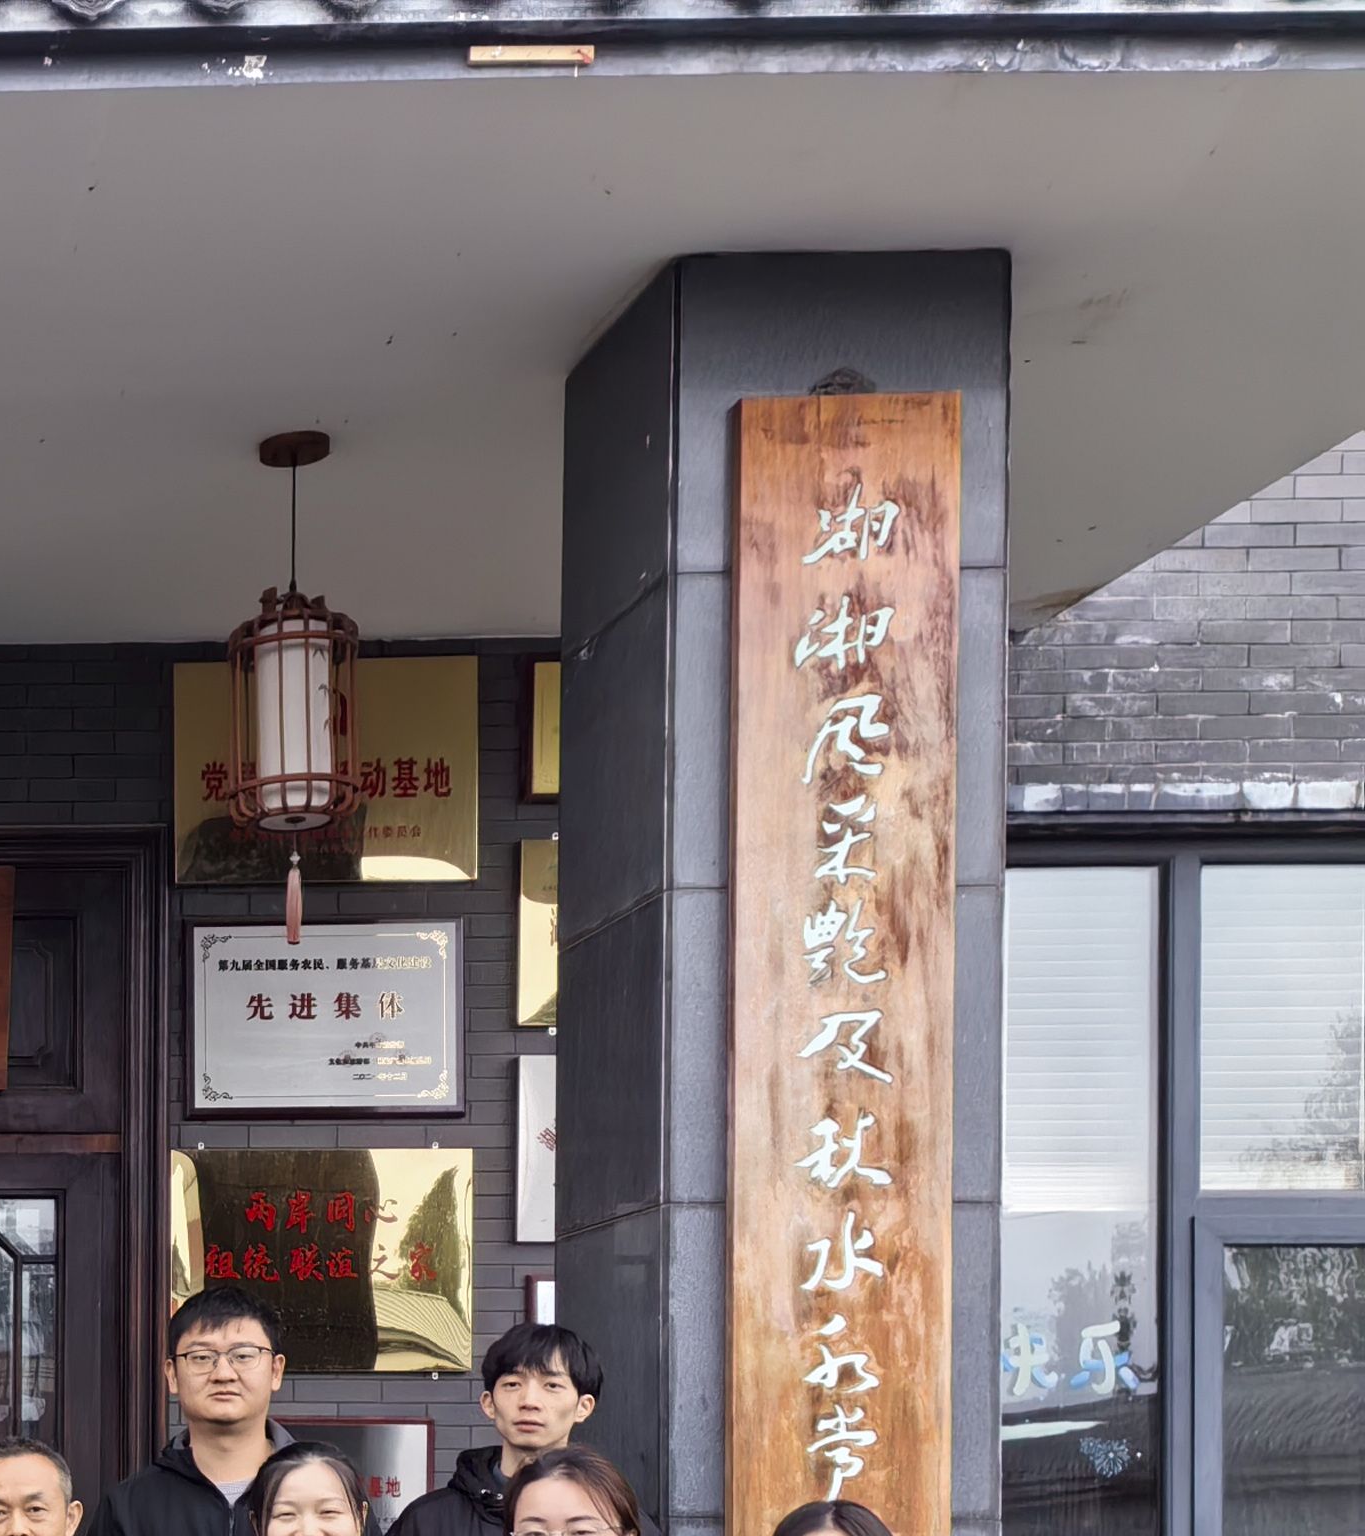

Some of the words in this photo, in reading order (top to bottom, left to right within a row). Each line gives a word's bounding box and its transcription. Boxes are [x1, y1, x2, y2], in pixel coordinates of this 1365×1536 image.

[201, 757, 453, 801] 党动基地
[246, 991, 405, 1021] 先进集体
